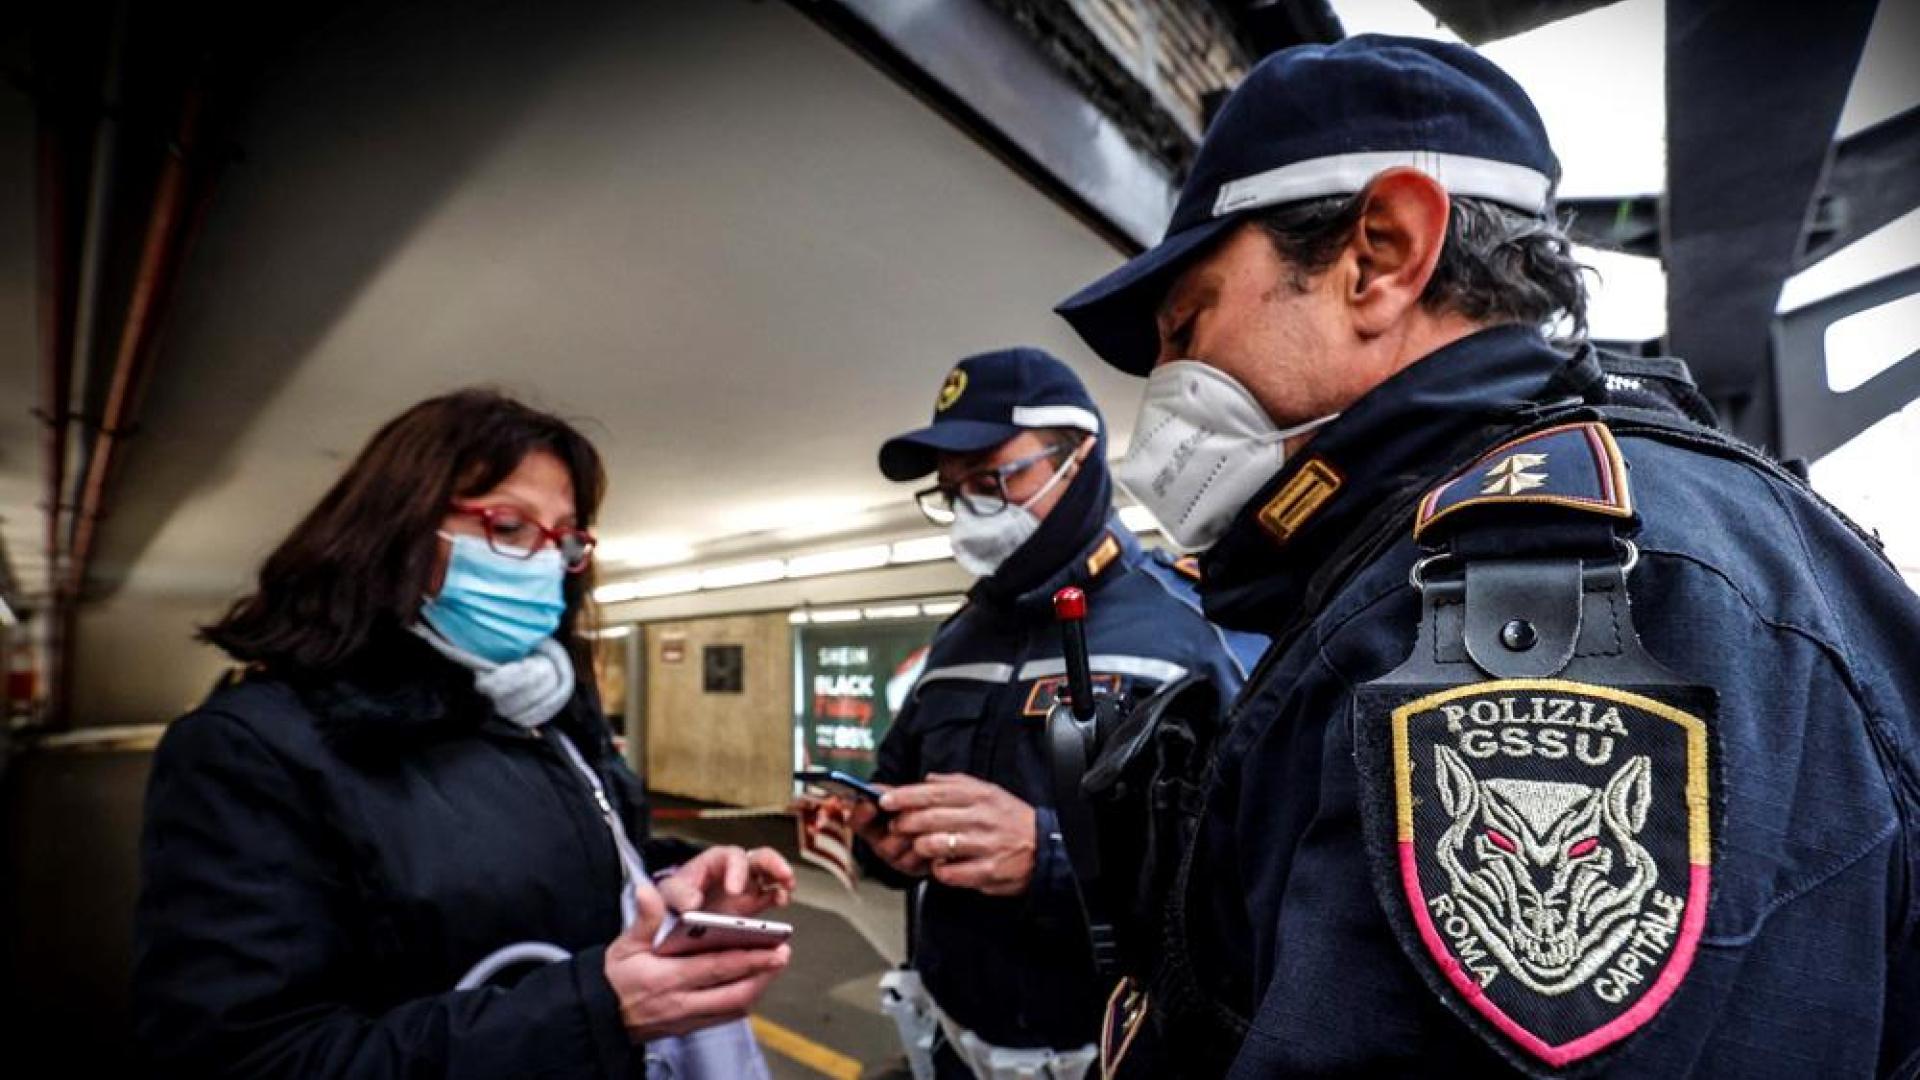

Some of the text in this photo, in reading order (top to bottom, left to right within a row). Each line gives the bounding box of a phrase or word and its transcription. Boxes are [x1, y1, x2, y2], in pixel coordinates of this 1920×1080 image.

[814, 675, 875, 697] BLACK
[1440, 697, 1629, 737] POLIZIA
[1460, 727, 1615, 765] GSSU
[1429, 892, 1500, 989] ROMA
[1592, 889, 1684, 1003] CAPITALE
